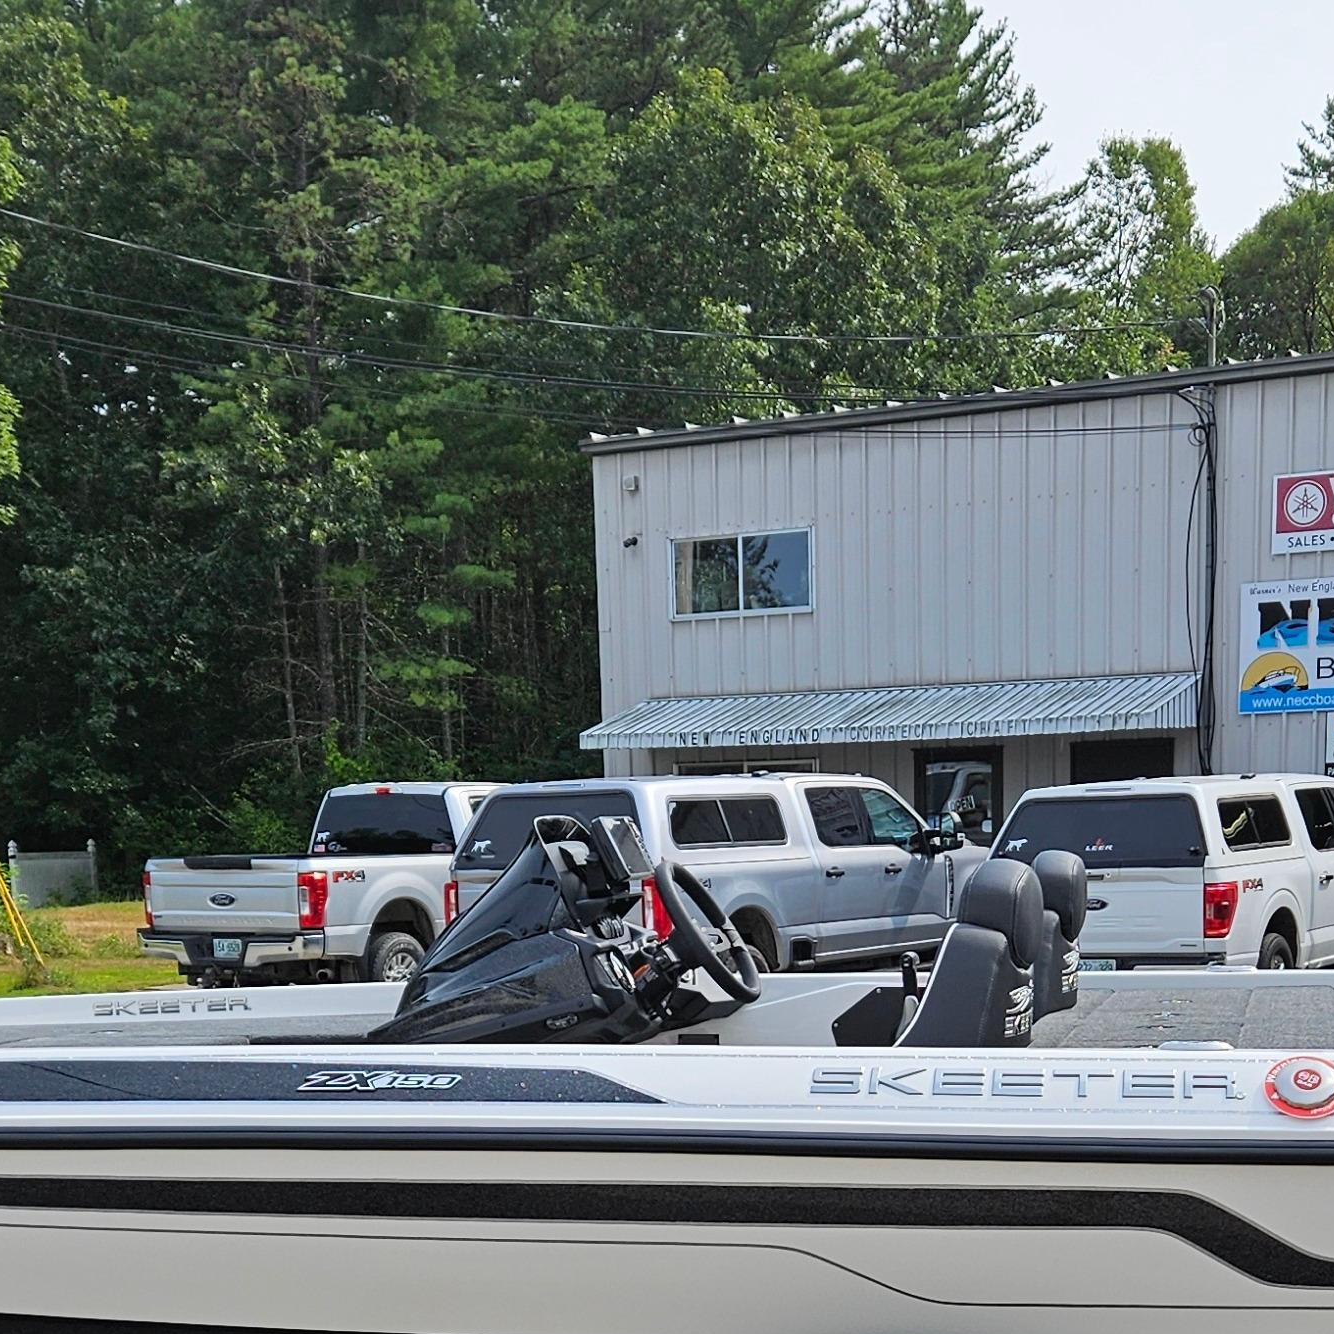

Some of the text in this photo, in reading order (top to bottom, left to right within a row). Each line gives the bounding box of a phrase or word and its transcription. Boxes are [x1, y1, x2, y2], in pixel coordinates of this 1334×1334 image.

[1288, 535, 1325, 548] SALES
[1288, 584, 1308, 593] New
[679, 718, 1028, 745] NEW ENGLAND CORRECT CRAFT
[332, 869, 365, 883] FX4
[93, 997, 249, 1017] SKEETER
[809, 1065, 1239, 1100] SKEETER
